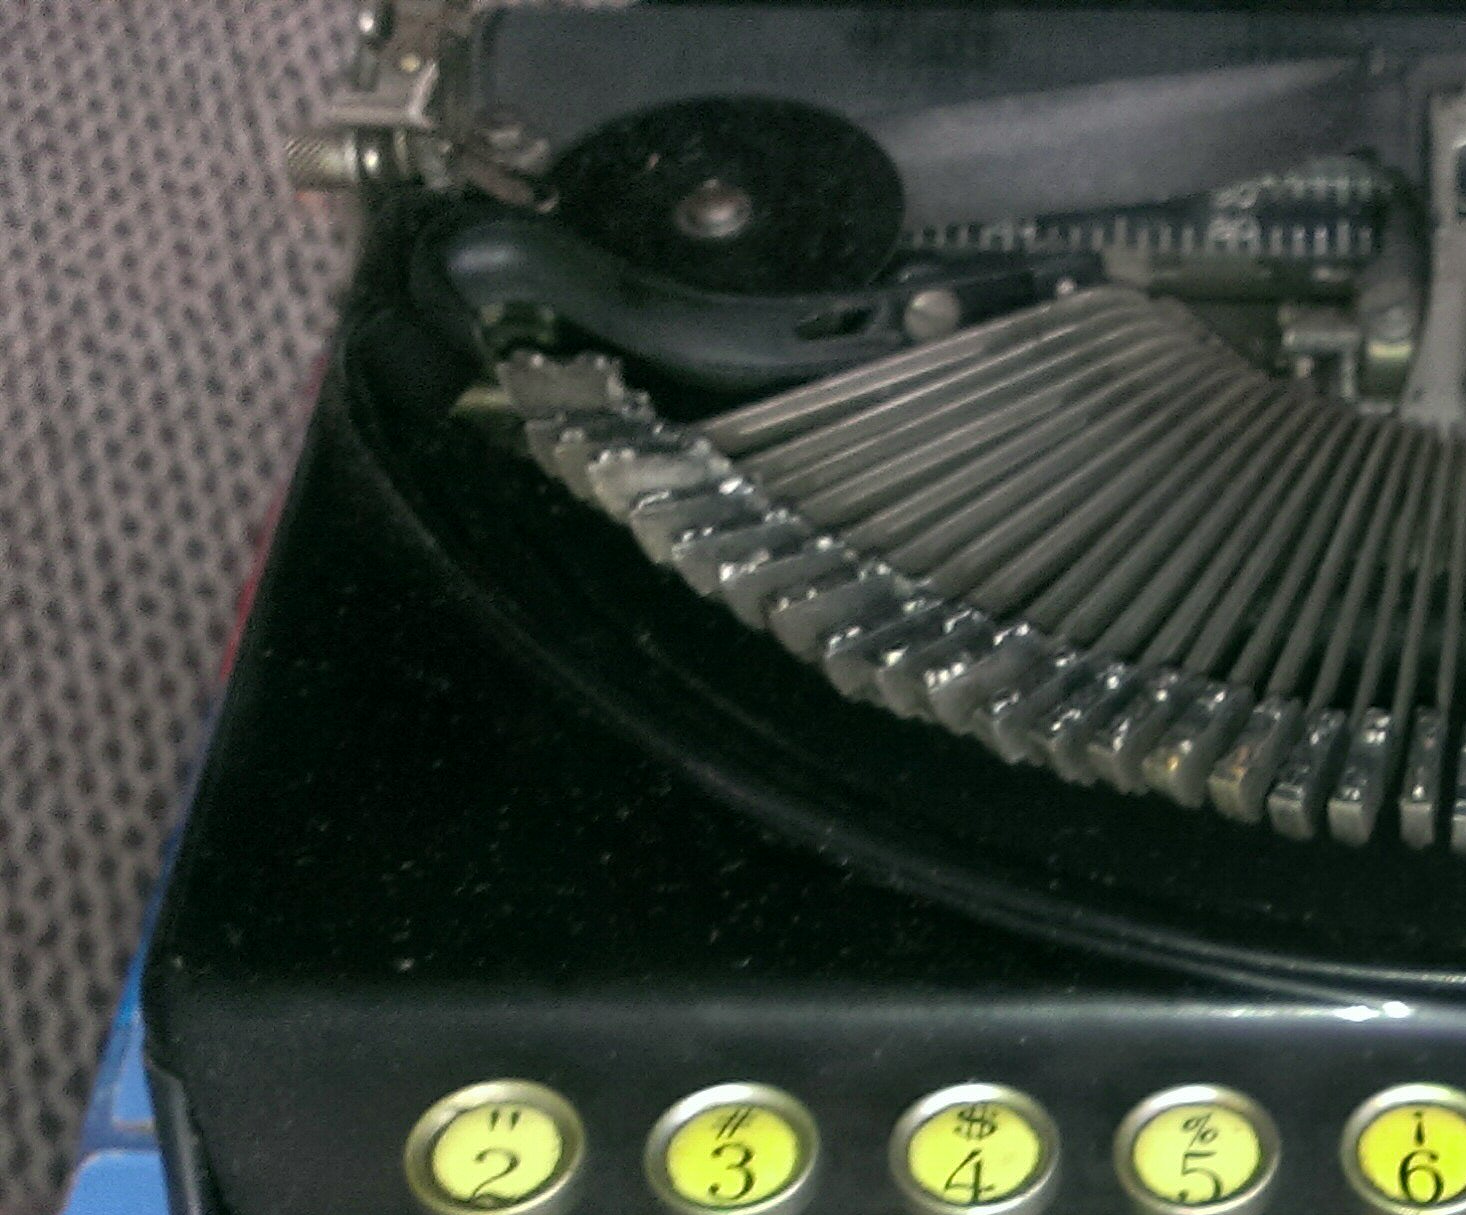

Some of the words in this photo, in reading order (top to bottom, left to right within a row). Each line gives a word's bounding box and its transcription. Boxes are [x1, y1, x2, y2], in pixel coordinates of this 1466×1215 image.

[953, 1103, 998, 1141] $
[1181, 1113, 1218, 1147] %
[470, 1147, 520, 1203] 2
[707, 1142, 755, 1200] 3
[943, 1149, 995, 1205] 4
[1177, 1150, 1224, 1202] 5
[1398, 1148, 1444, 1205] 6
